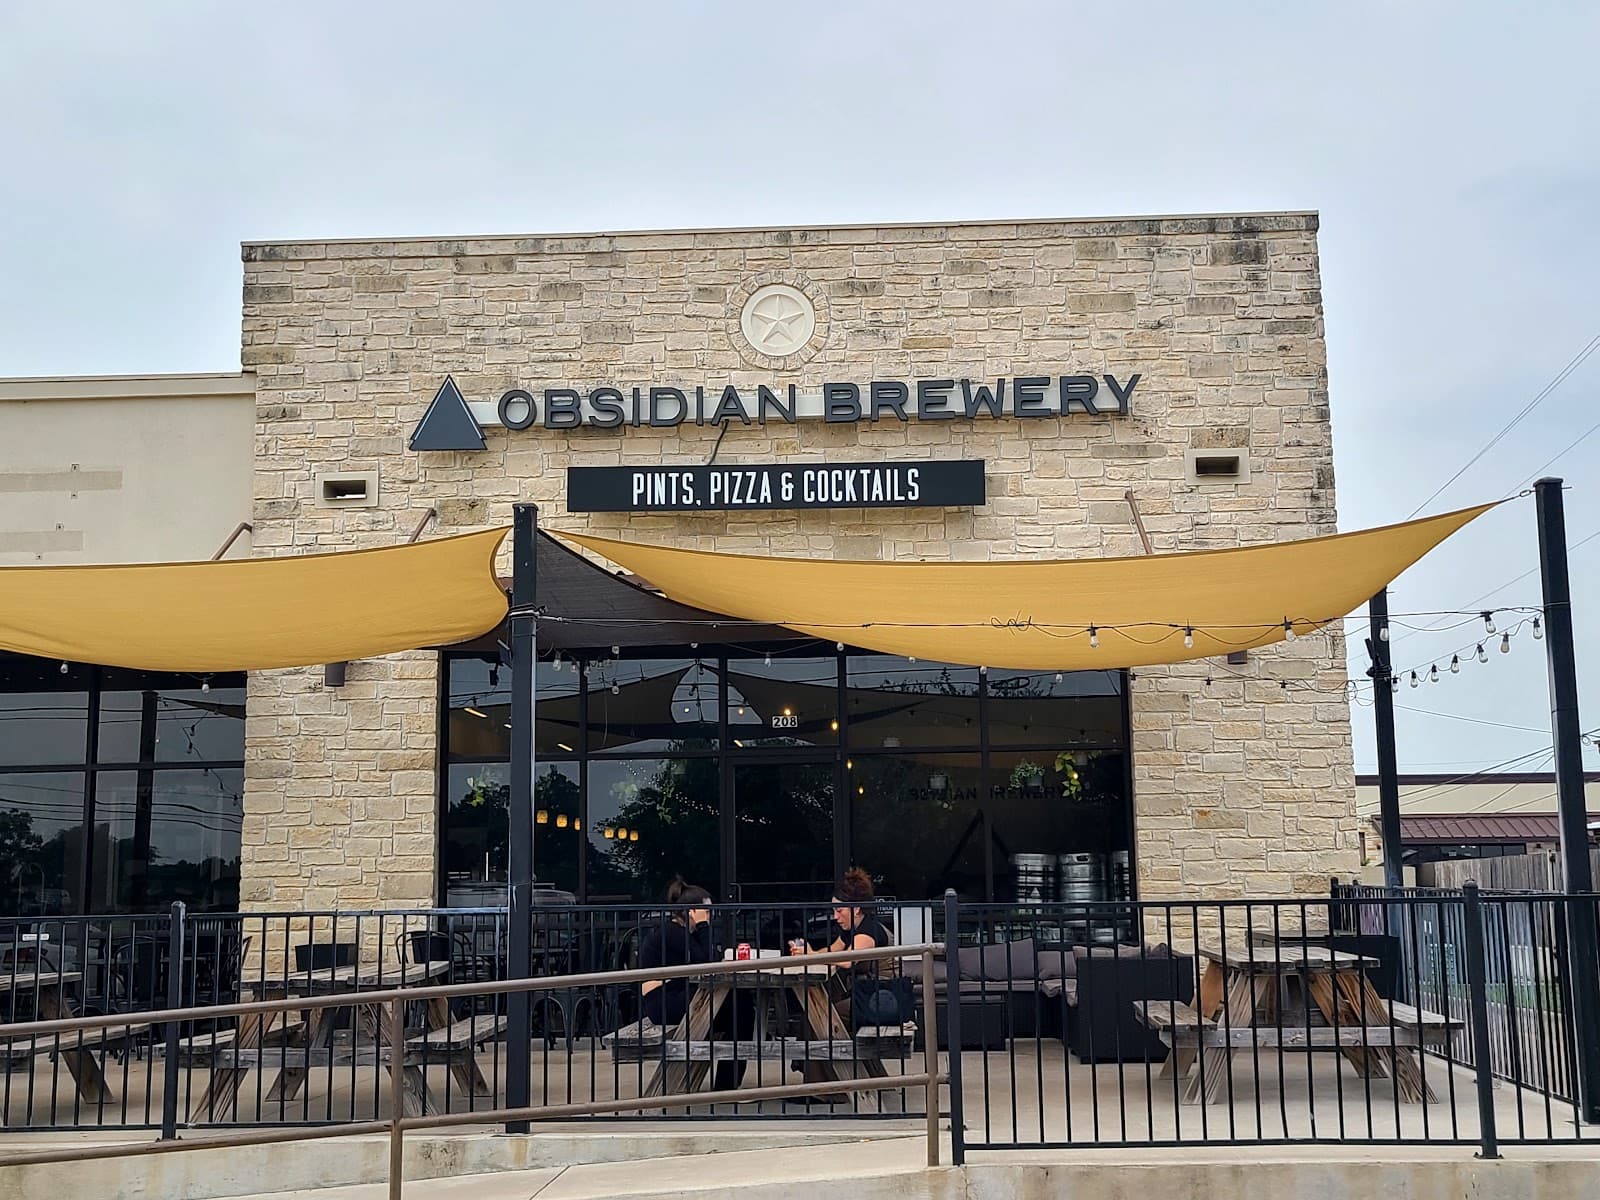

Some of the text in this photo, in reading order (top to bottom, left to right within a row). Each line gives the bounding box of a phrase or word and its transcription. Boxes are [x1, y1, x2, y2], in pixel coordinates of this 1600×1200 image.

[497, 374, 1142, 430] OBSIDIAN BREWERY
[632, 468, 920, 506] PINTS, PIZZA & COCKTAILS
[773, 716, 797, 727] 208
